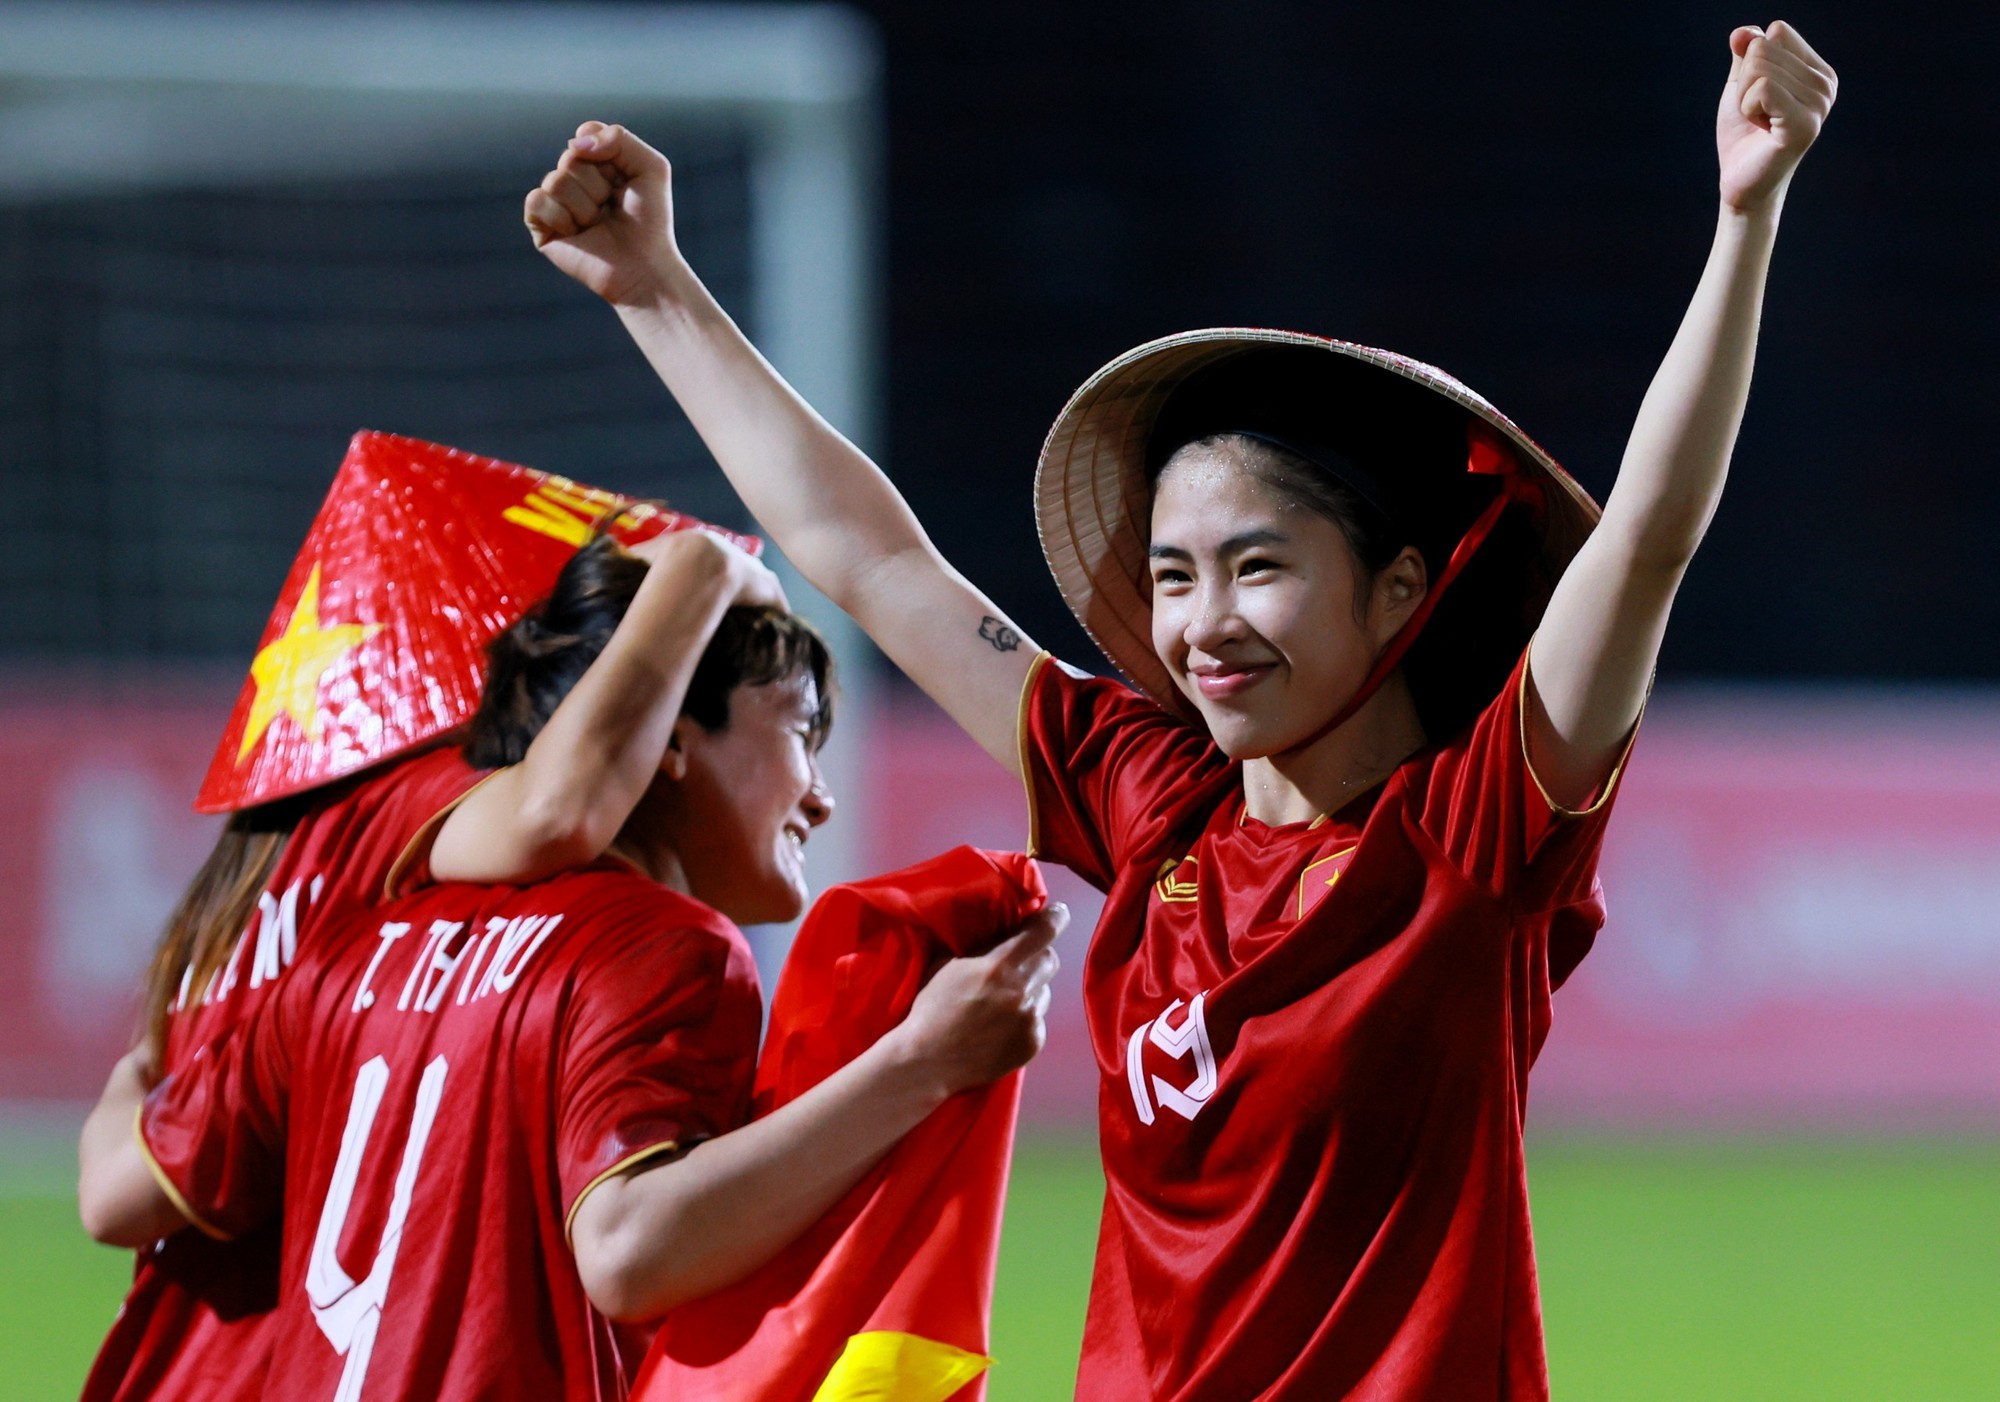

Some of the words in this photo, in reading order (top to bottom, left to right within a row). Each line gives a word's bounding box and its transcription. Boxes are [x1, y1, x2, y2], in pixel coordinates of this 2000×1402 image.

[351, 921, 412, 1013] T.
[1127, 989, 1218, 1126] 19
[304, 1053, 450, 1402] 4
